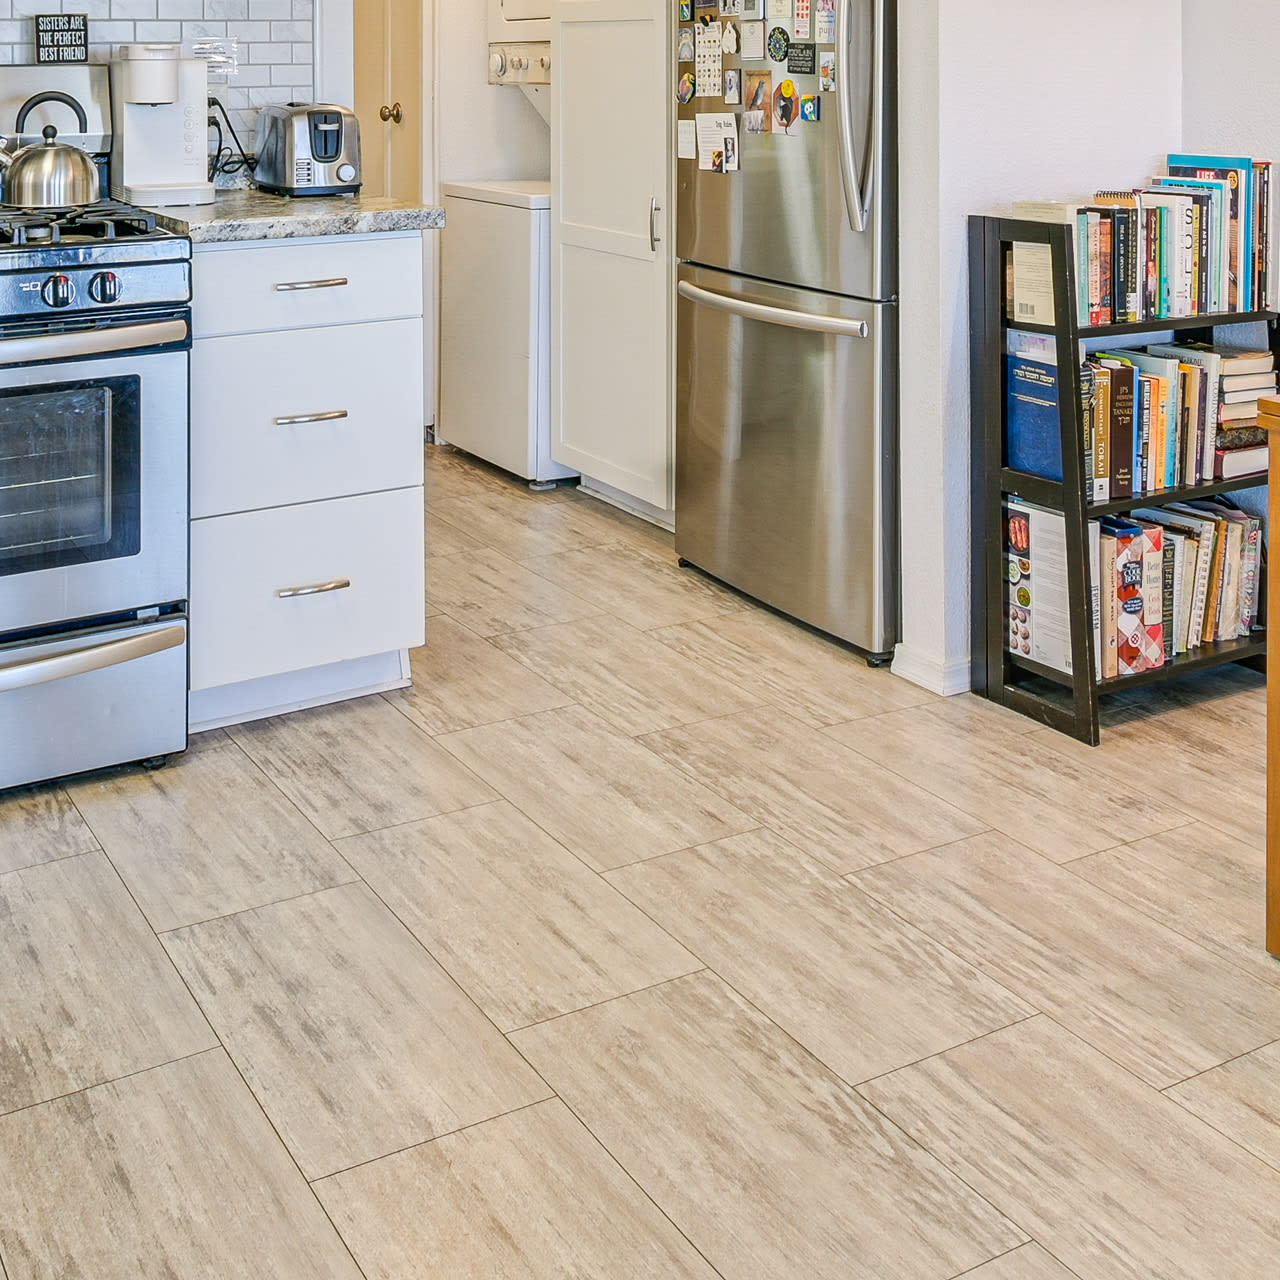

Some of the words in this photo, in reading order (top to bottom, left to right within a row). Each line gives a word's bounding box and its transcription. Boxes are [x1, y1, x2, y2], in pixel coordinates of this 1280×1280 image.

[38, 16, 69, 30] SISTERS
[70, 16, 85, 30] ARE
[39, 31, 53, 45] THE
[54, 31, 85, 45] PERFECT
[40, 47, 58, 61] BEST
[59, 46, 86, 60] FRIEND
[1210, 381, 1219, 419] COMING
[1097, 442, 1105, 475] TORAH
[1091, 585, 1099, 630] JERUSALEM
